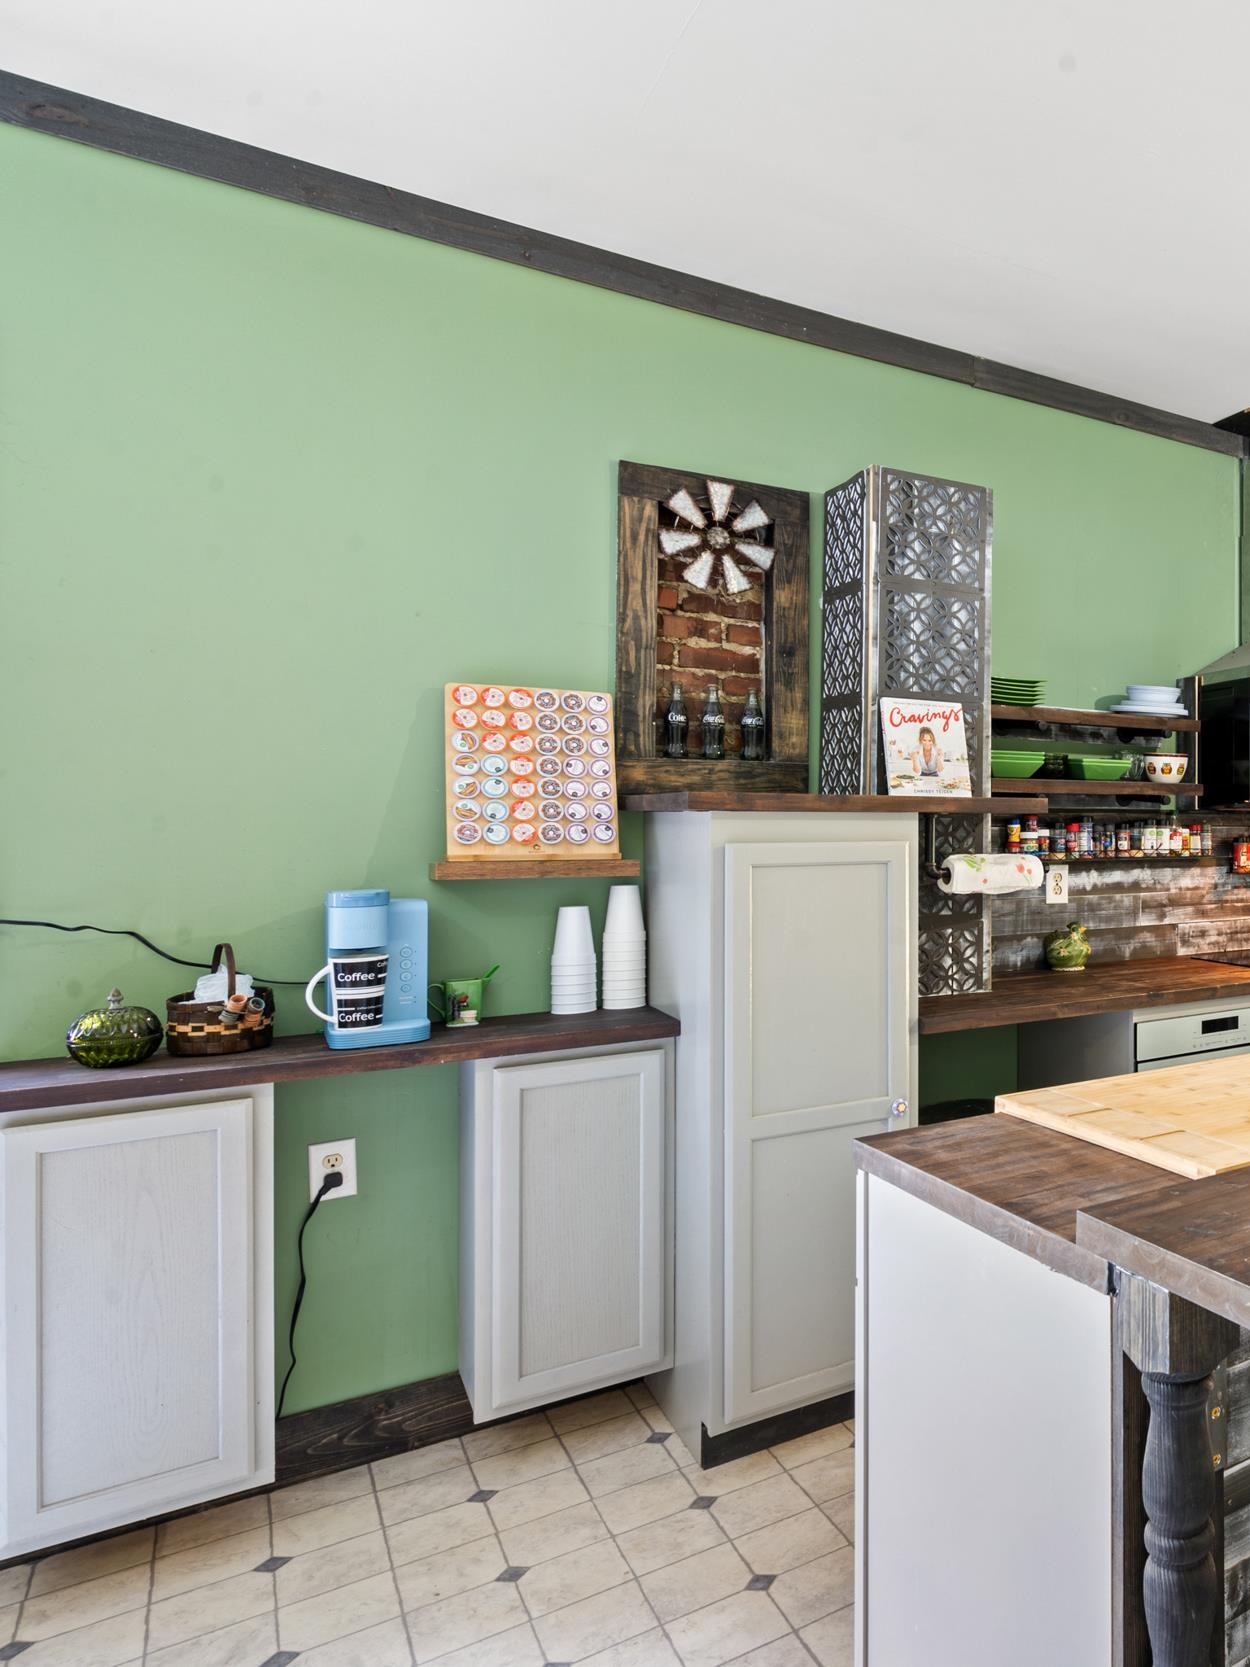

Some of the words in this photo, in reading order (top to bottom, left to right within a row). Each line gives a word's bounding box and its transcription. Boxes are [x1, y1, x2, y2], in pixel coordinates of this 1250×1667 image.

[889, 707, 962, 732] Cravings
[337, 972, 376, 982] Coffee
[339, 1012, 375, 1022] Coffee
